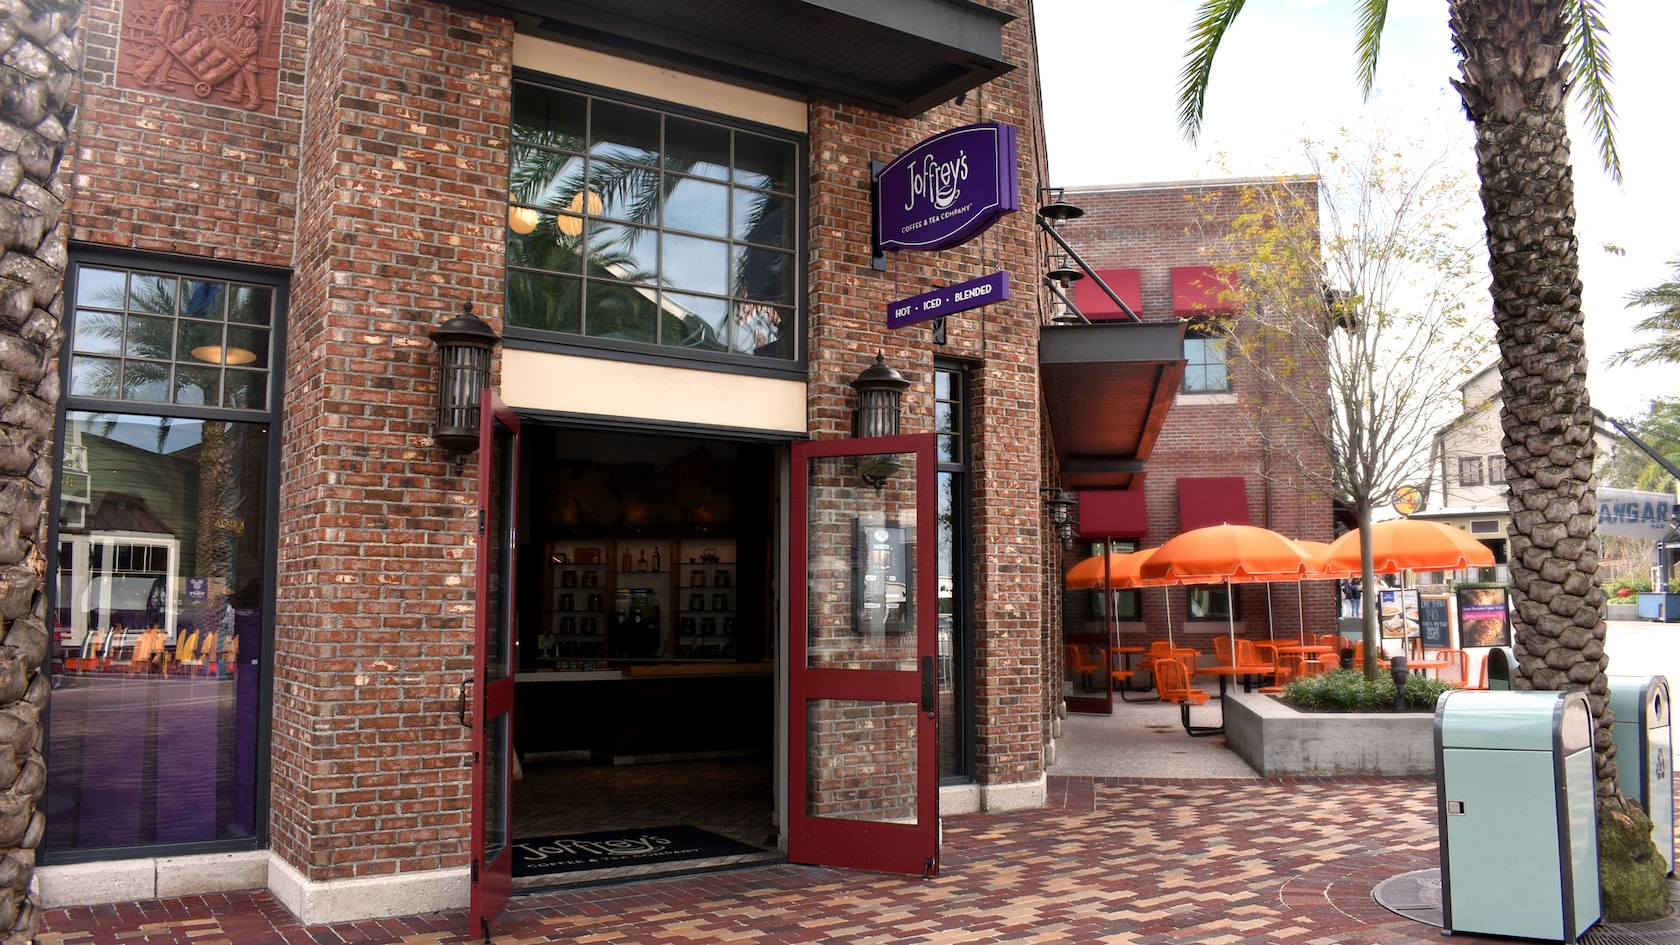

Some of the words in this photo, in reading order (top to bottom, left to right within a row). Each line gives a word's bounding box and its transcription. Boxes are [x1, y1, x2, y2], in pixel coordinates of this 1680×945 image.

[904, 149, 969, 210] Joffrey's
[901, 221, 923, 234] COFFEE
[928, 216, 941, 225] TEA
[940, 205, 971, 220] COMPANY
[895, 307, 912, 318] HOT
[923, 298, 942, 311] ICED
[954, 284, 993, 303] BLENDED
[1598, 501, 1669, 524] ANGAR
[512, 835, 671, 860] Joffrey's
